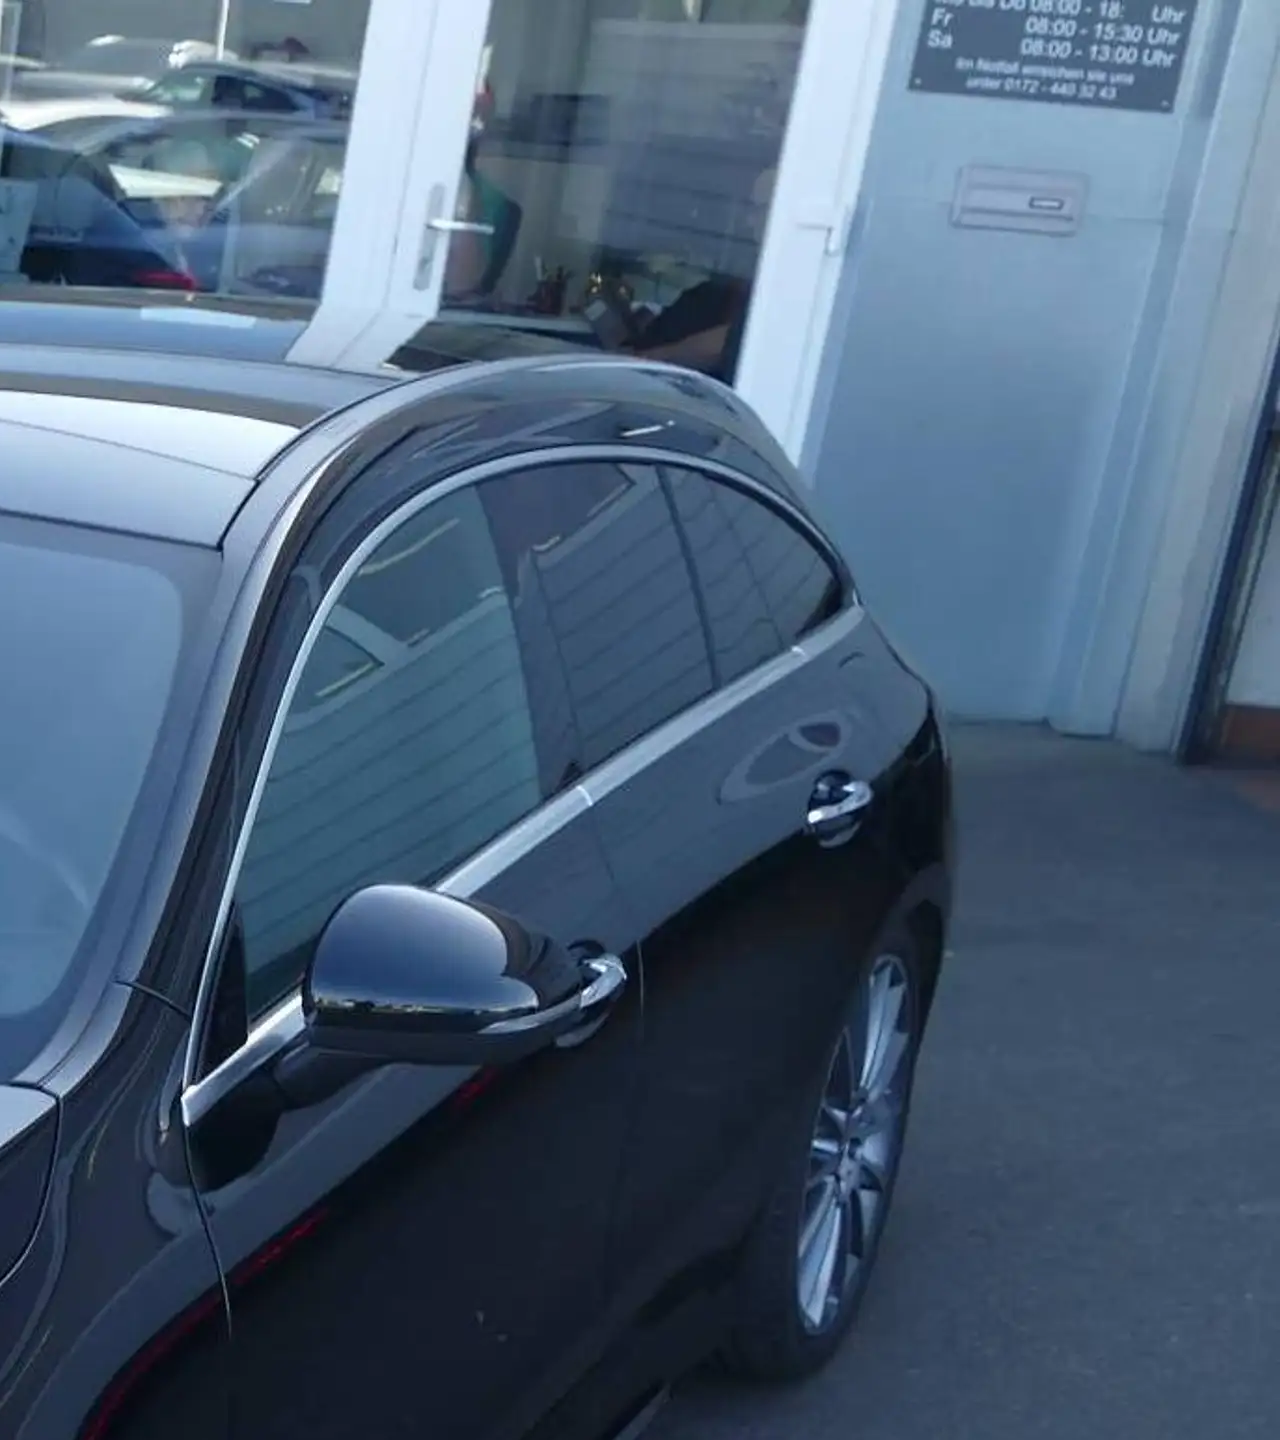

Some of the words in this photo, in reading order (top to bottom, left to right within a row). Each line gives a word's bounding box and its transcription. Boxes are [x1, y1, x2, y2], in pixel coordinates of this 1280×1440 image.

[931, 7, 954, 27] Fr
[1025, 15, 1077, 37] 08:00
[1094, 22, 1143, 43] 15:30
[1147, 27, 1181, 45] Uhr
[1152, 4, 1187, 24] Uhr
[927, 29, 952, 48] Sa
[1021, 37, 1072, 58] 08:00
[1091, 44, 1138, 64] 13:00
[1143, 48, 1177, 67] Uhr
